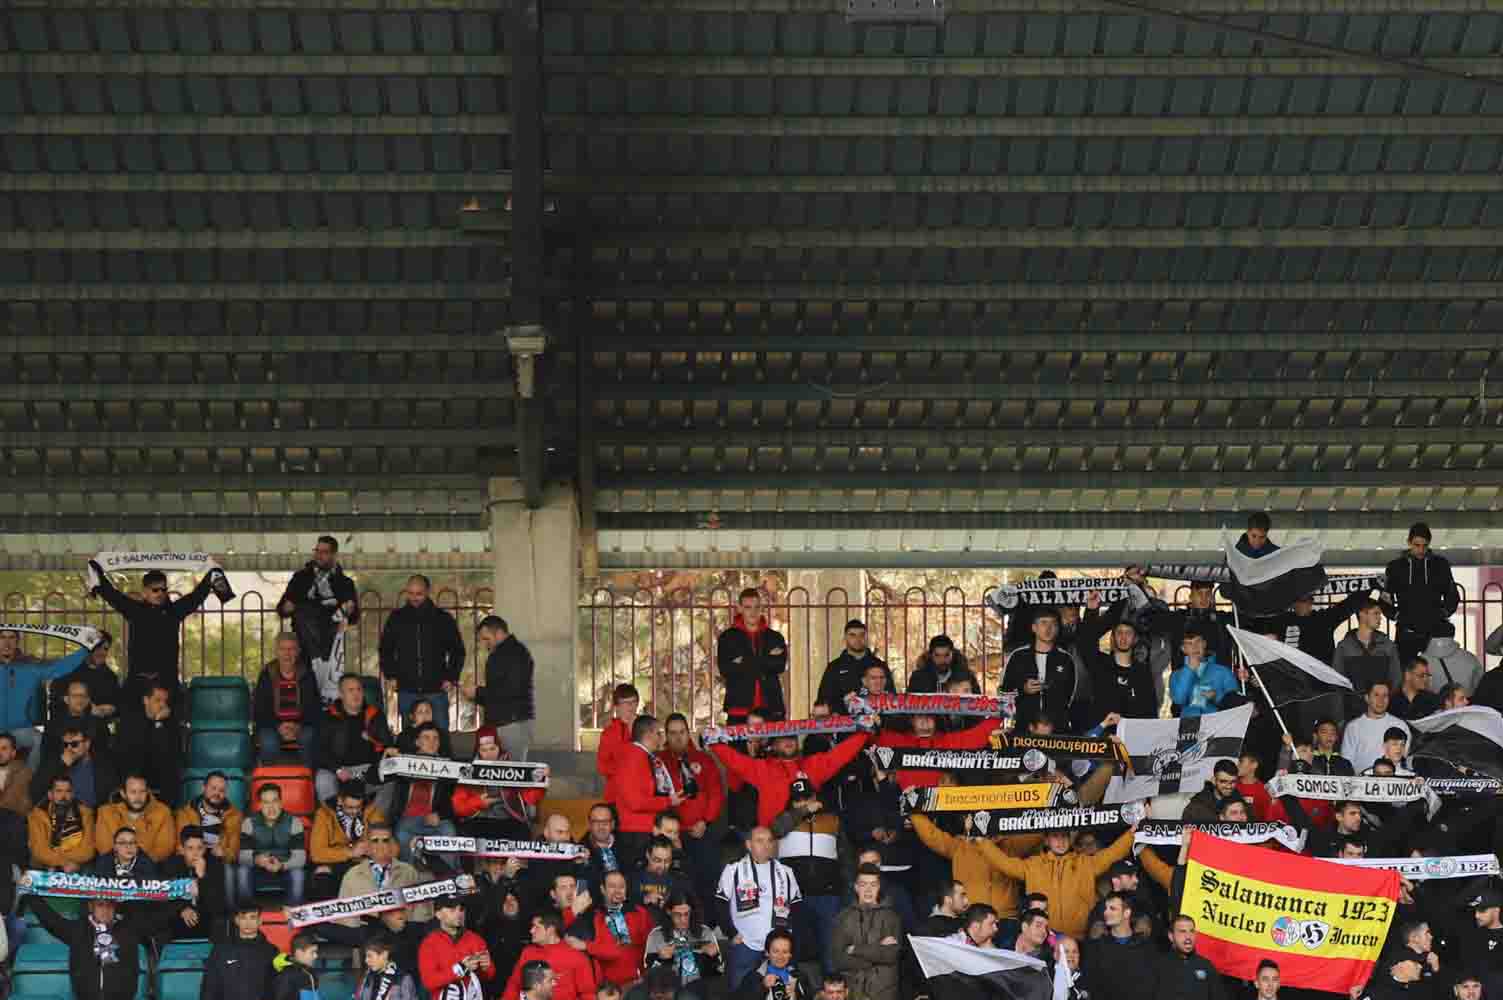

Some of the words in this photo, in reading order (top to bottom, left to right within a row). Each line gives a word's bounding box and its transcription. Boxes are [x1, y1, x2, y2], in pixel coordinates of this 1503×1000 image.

[1061, 577, 1126, 588] DEPORTIV
[407, 759, 450, 775] HALA
[1296, 779, 1338, 794] SOMOS
[1364, 782, 1379, 796] LA
[50, 875, 137, 890] SALAMANCA
[142, 879, 171, 891] UDS
[403, 880, 456, 900] CHARRO
[1200, 869, 1328, 918] Salamanca
[1340, 898, 1390, 923] 1923
[1202, 903, 1267, 935] Nucleo
